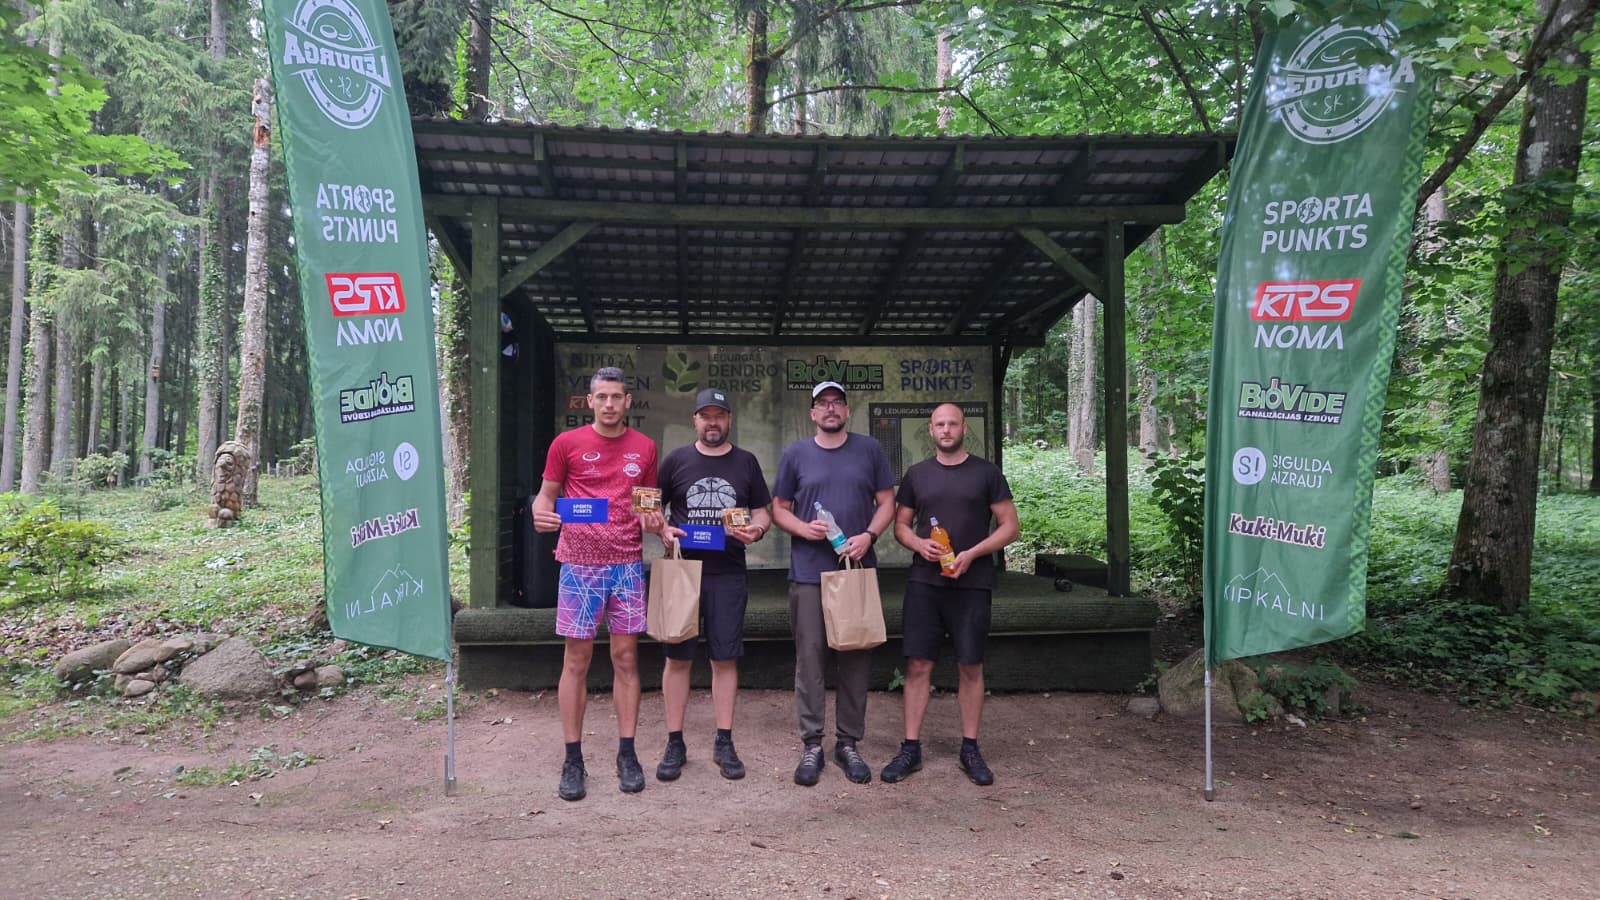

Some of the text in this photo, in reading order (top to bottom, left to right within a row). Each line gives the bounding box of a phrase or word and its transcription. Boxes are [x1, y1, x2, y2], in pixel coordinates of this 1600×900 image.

[1263, 193, 1373, 225] SPORTA
[1260, 224, 1368, 253] PUNKTS
[1254, 325, 1345, 350] NOMA
[708, 364, 779, 377] DENDRO
[900, 359, 975, 375] SPORTA
[708, 379, 762, 392] PARKS
[901, 376, 973, 391] PUNKTS
[1270, 470, 1322, 489] AIZRAUJ
[1229, 513, 1326, 549] Kuki-Muki
[1224, 584, 1324, 621] KIPKALNI
